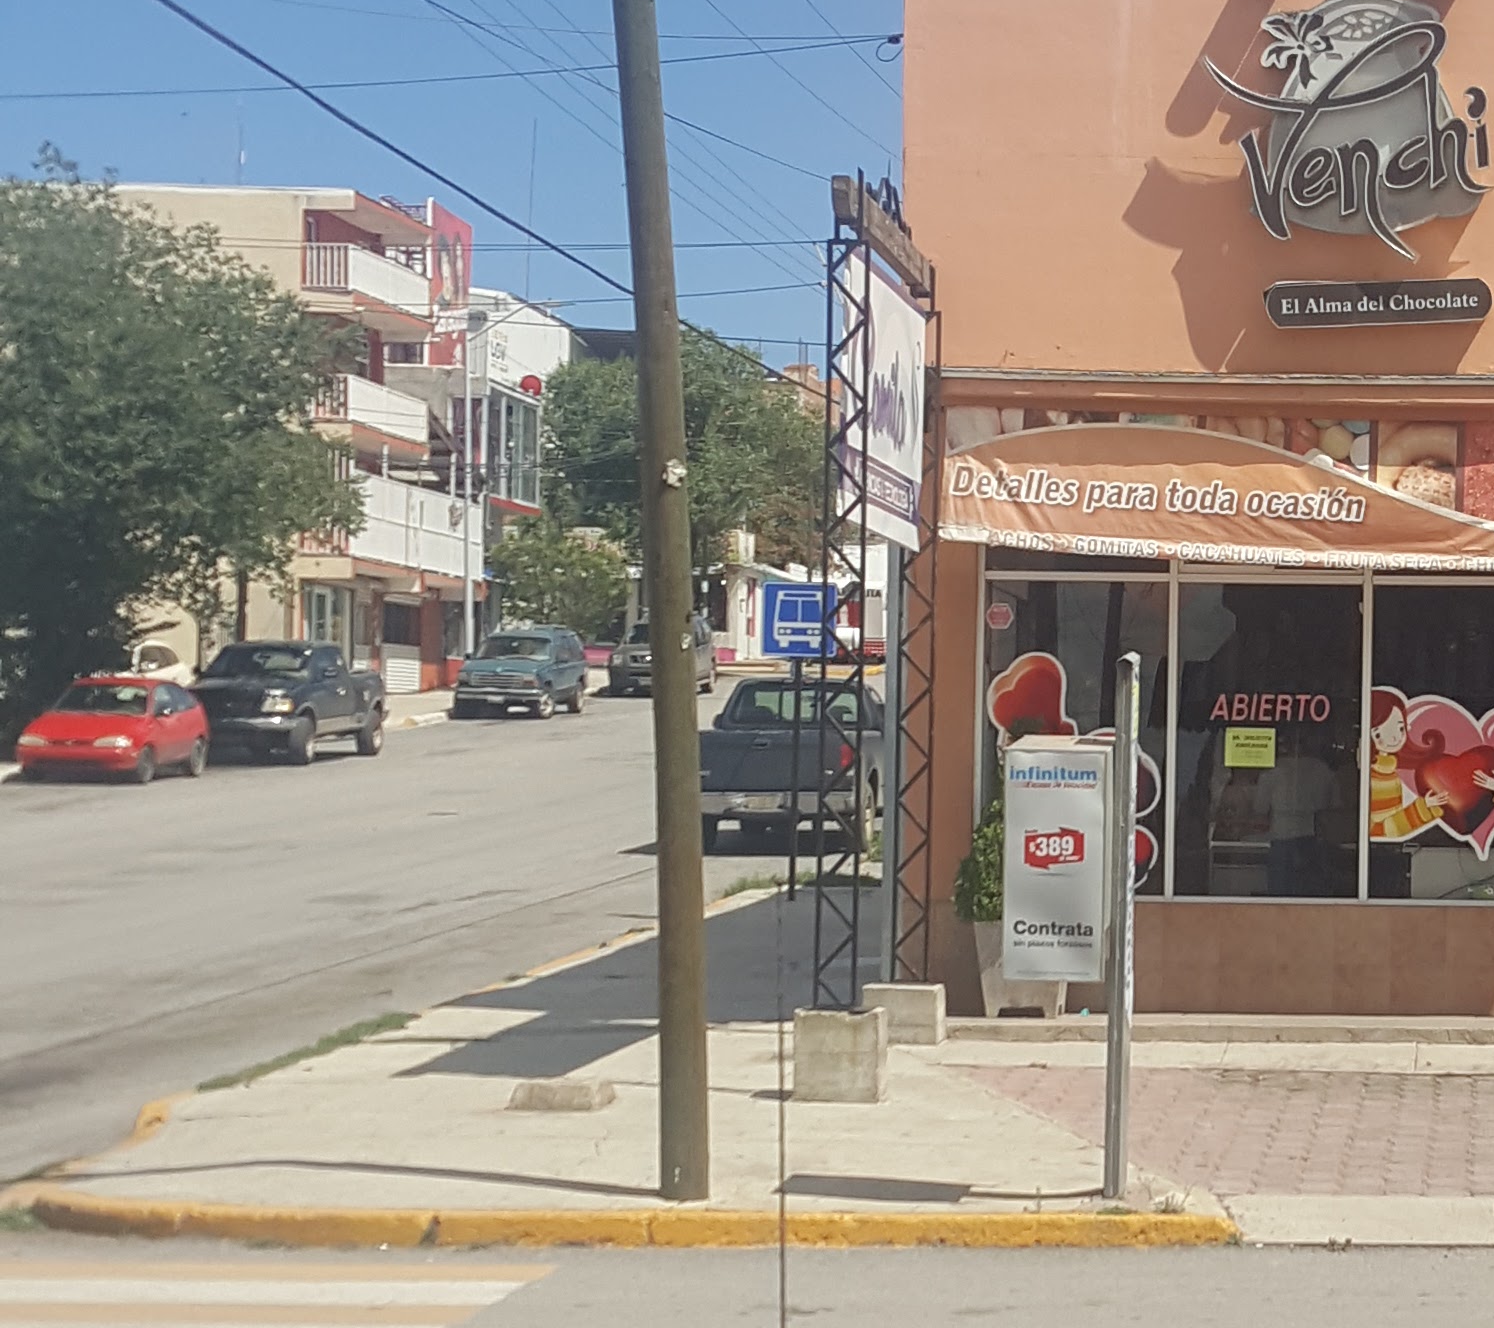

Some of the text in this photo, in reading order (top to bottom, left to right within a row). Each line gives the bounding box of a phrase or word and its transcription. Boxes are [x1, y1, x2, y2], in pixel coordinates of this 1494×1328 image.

[1202, 21, 1494, 263] Venchi
[1280, 292, 1478, 315] El Alma del Chocolate
[951, 461, 1079, 508] Detalles
[1083, 479, 1158, 514] para
[1165, 478, 1237, 516] toda
[1243, 485, 1367, 523] ocasión
[988, 530, 1054, 552] ACHOS
[1073, 533, 1159, 559] GOMITAS
[1178, 541, 1306, 566] CACAHUATES
[1324, 551, 1387, 570] FRUTA
[1209, 692, 1331, 722] ABIERTO
[1009, 765, 1098, 781] infinitum
[1028, 835, 1075, 857] $389
[1013, 920, 1094, 937] Contrata
